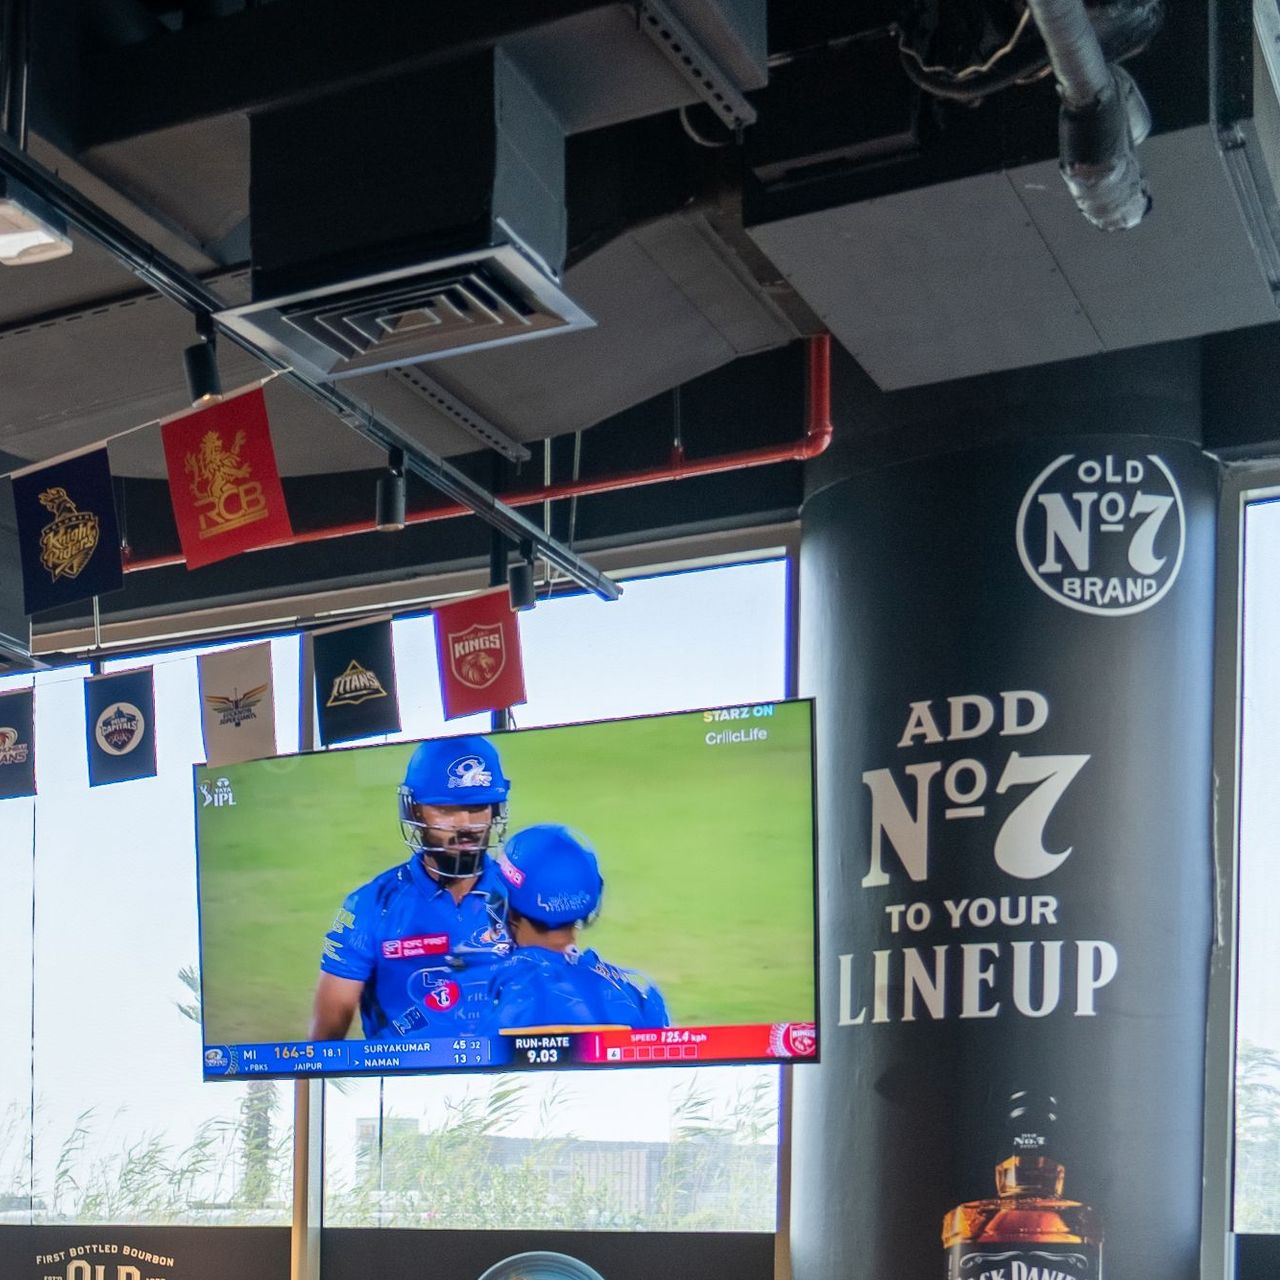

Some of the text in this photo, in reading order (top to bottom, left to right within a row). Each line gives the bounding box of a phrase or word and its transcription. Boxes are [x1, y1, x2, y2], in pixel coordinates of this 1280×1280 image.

[1078, 455, 1144, 483] OLD
[199, 481, 266, 530] RCB
[46, 523, 92, 549] Knight
[47, 535, 94, 564] Riders
[1063, 577, 1157, 606] BRAND
[454, 633, 501, 658] KINGS
[332, 671, 377, 695] TITANS
[704, 705, 774, 722] STARZ ON
[896, 690, 1049, 747] ADD
[101, 719, 138, 736] CAPITALS
[214, 792, 236, 806] IPL
[885, 896, 1058, 933] TO YOUR
[837, 939, 1119, 1027] LINEUP
[515, 1036, 569, 1049] RUN-RATE
[631, 1030, 707, 1043] SPEED 125.4 kph
[243, 1046, 341, 1059] MI 164-5 18.1
[363, 1041, 481, 1053] SURYAKUMAR 45 32
[527, 1050, 557, 1063] 9.03
[293, 1062, 323, 1071] JAIPUR
[364, 1054, 481, 1067] NAMAN 13 9
[1014, 1137, 1045, 1145] No.7
[36, 1245, 174, 1267] FIRST BOTTLED BOURBON
